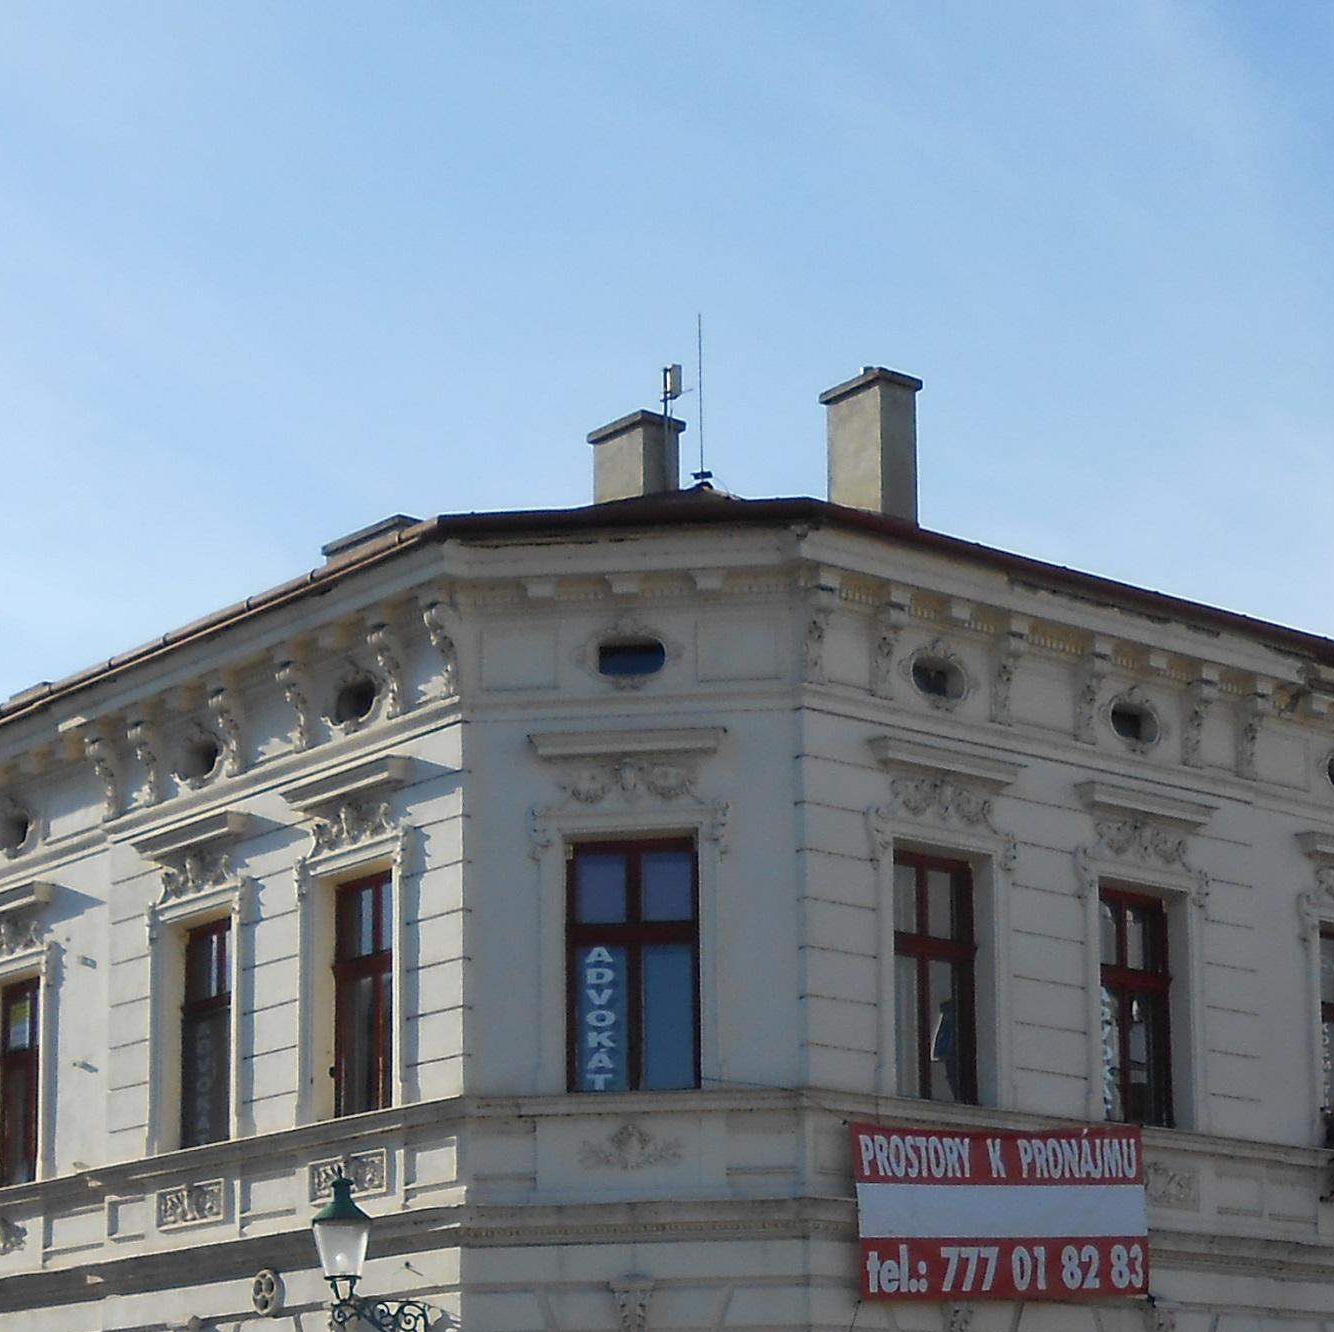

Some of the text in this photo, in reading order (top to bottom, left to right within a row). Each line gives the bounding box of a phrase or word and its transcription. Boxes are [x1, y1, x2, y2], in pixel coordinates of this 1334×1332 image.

[586, 946, 616, 1091] ADVOKÁT
[860, 1128, 1137, 1179] PROSTORY K PRONÁJMU
[867, 1244, 1144, 1293] tel.: 777 01 82 83
